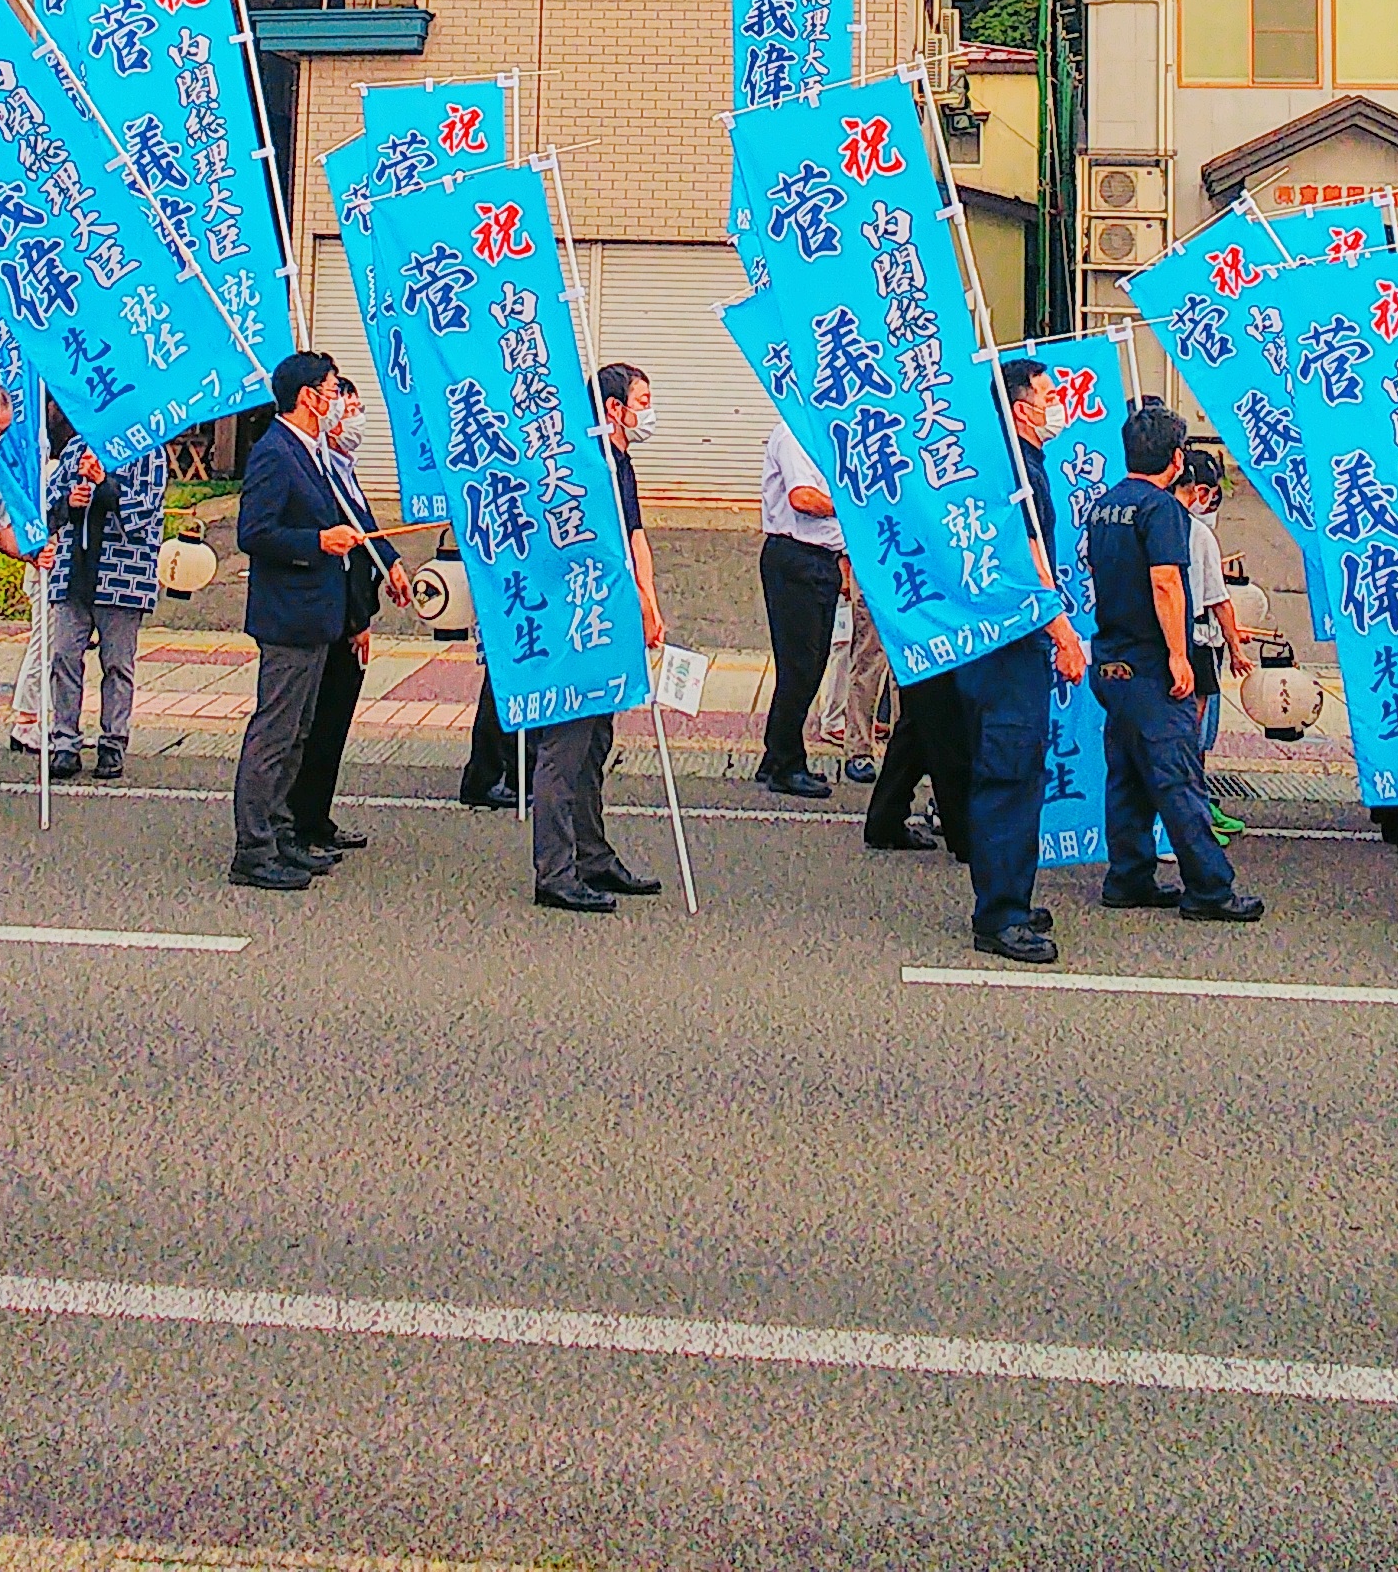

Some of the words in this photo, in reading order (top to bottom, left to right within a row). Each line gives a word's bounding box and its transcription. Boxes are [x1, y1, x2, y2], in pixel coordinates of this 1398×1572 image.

[439, 103, 489, 157] 祝
[839, 115, 905, 184] 祝
[473, 202, 535, 266] 祝
[1205, 243, 1263, 299] 祝
[104, 367, 223, 462] 松田グループ
[1053, 367, 1107, 428] 祝
[902, 592, 1045, 676] 松田グループ
[506, 675, 630, 727] 松田グループ
